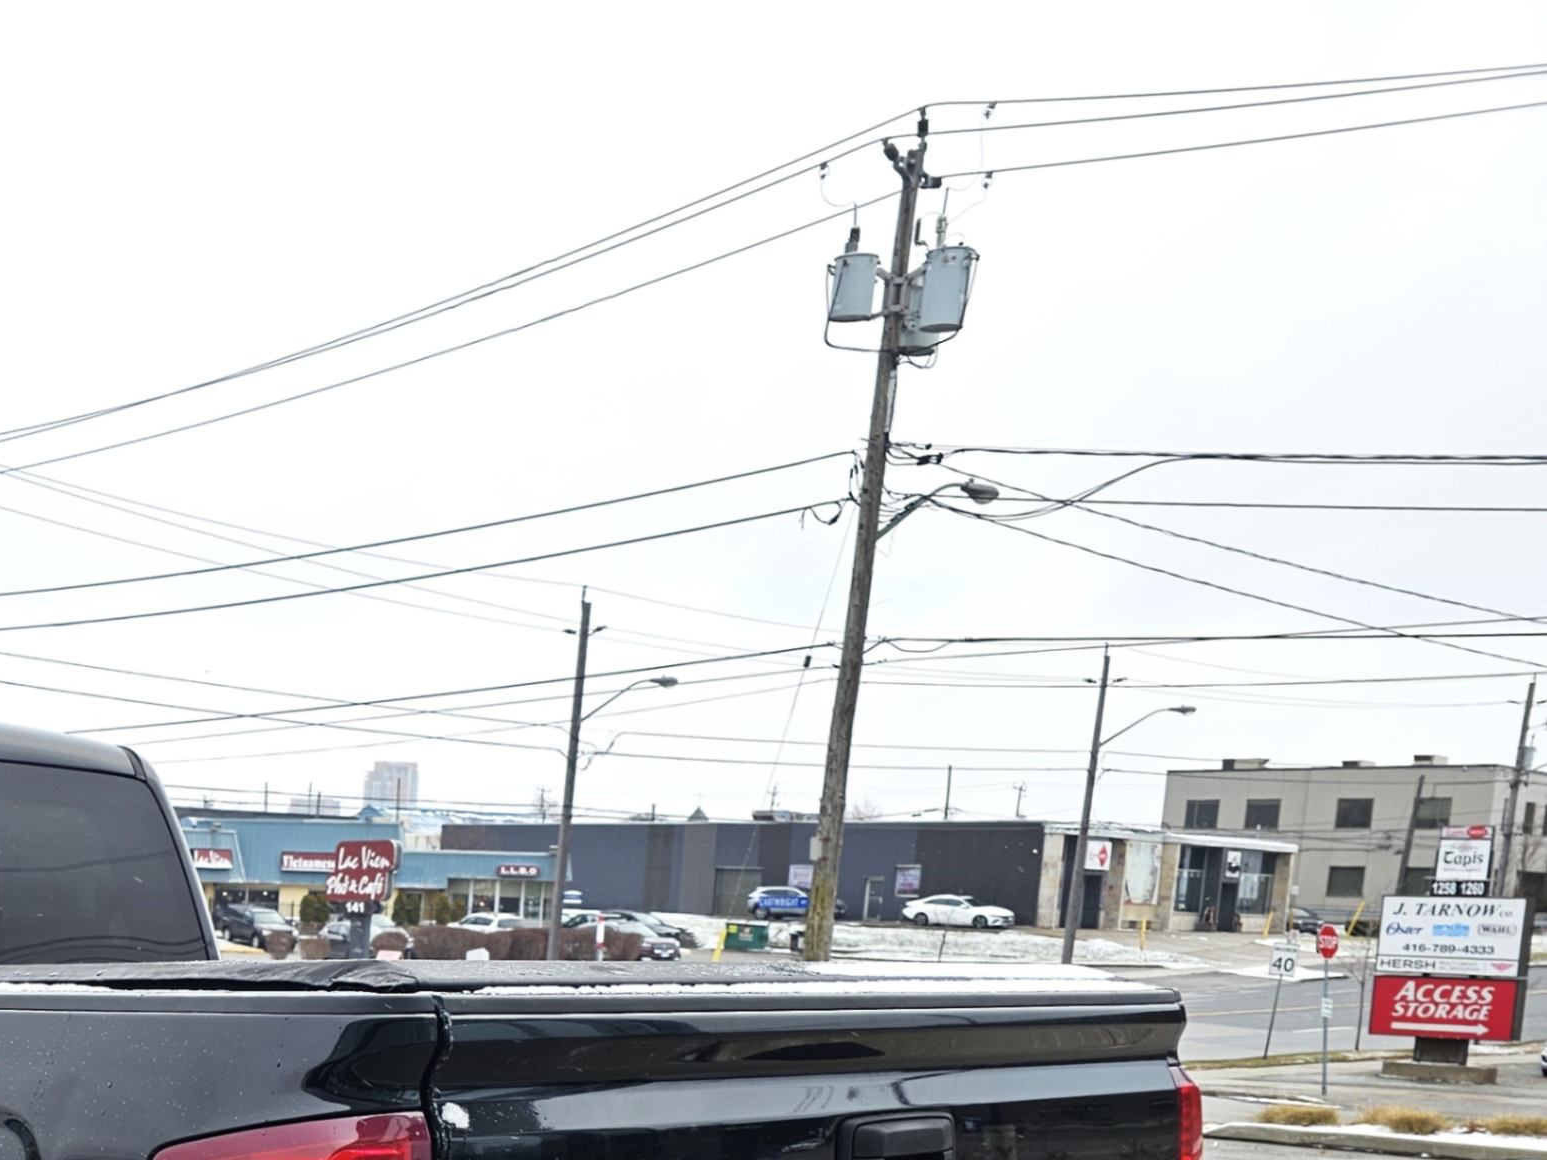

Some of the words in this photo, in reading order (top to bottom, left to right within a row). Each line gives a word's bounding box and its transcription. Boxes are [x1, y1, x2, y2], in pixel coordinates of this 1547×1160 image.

[345, 901, 365, 913] 141
[1393, 902, 1407, 916] J.
[1415, 902, 1498, 918] TARNOW
[1319, 935, 1338, 950] STOP
[1402, 943, 1495, 955] 416-789-4333
[1272, 956, 1295, 973] 40
[1379, 959, 1437, 970] HERSH
[1394, 980, 1495, 1005] ACCESS
[1391, 1001, 1493, 1021] STORAGE
